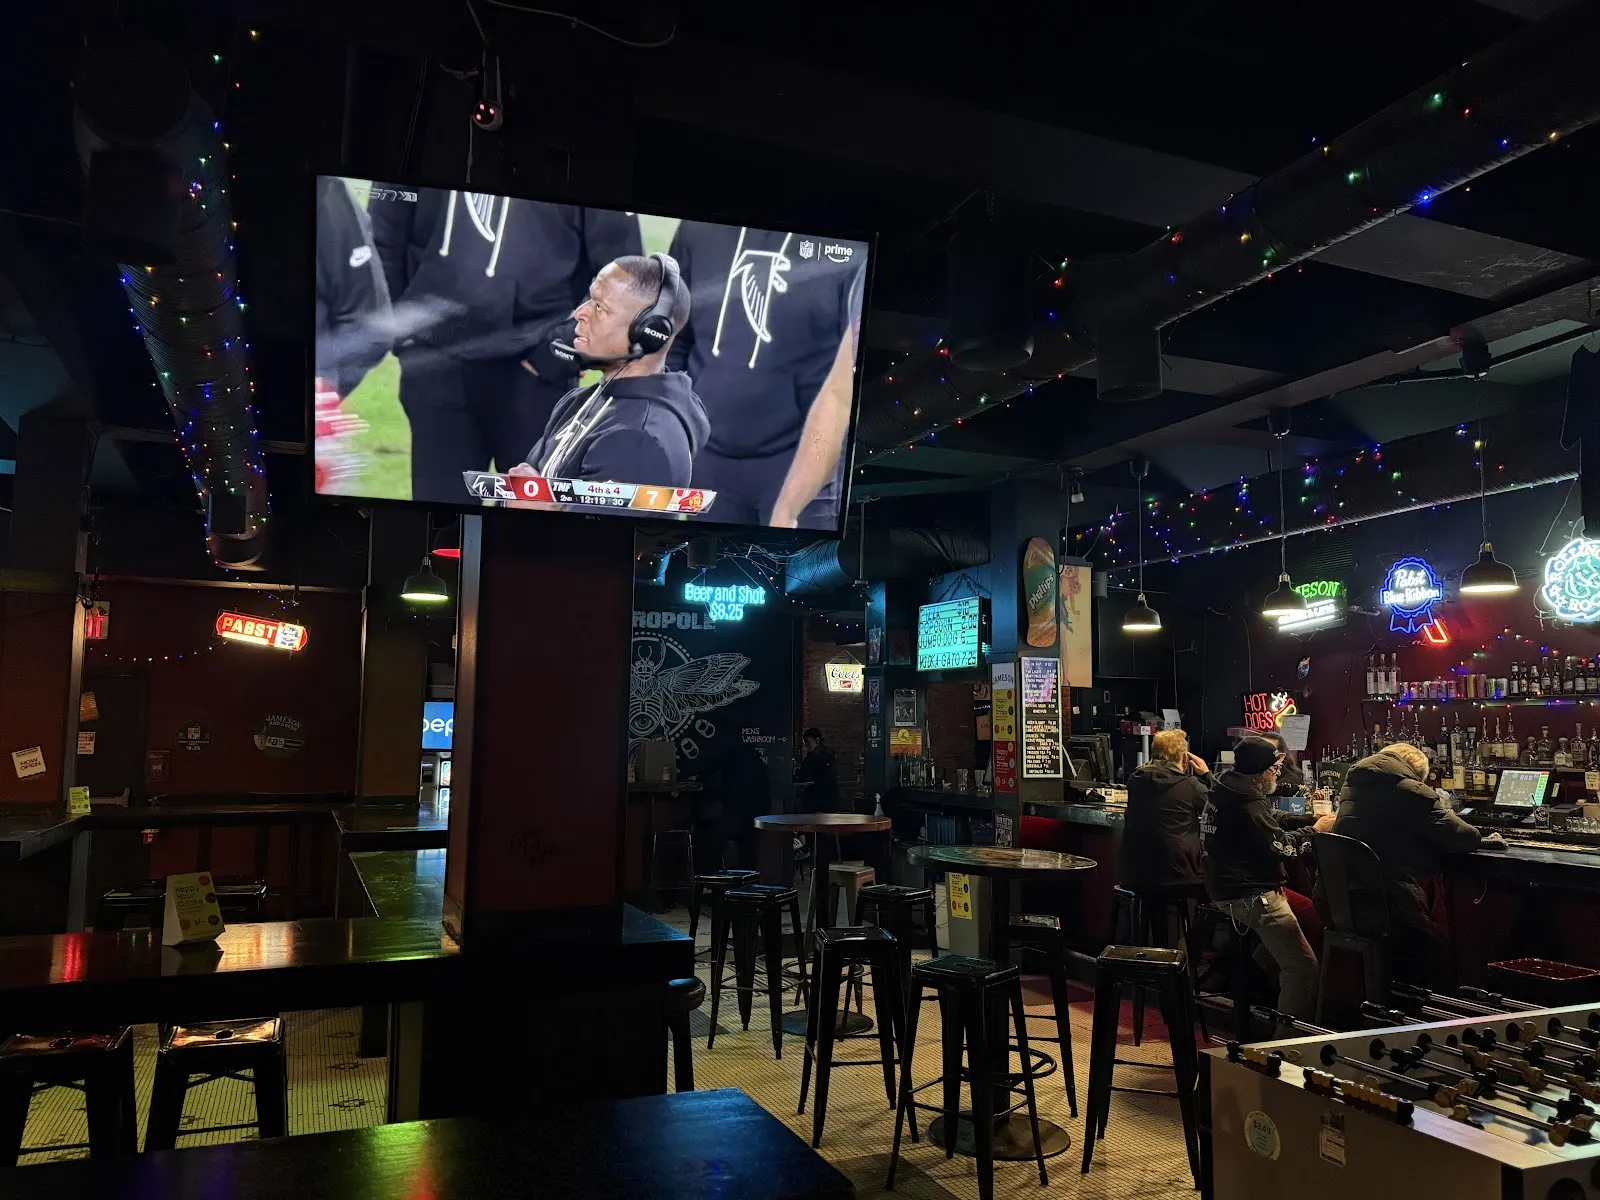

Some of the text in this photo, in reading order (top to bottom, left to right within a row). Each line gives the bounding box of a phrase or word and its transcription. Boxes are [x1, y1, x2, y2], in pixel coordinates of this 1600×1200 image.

[825, 244, 852, 256] prime
[644, 327, 668, 341] SONY
[555, 349, 574, 360] SONY
[523, 480, 539, 498] 0
[552, 482, 572, 492] TNF
[588, 485, 604, 494] 4th
[613, 487, 620, 495] 4
[580, 496, 606, 504] 12:19
[647, 490, 659, 506] 7
[1395, 569, 1426, 587] Pabst
[685, 583, 766, 604] Beer and Shot
[1028, 573, 1055, 609] Phillips
[1296, 581, 1340, 598] ESON
[1383, 587, 1440, 604] Blue Ribbon
[710, 601, 743, 621] $8.25
[222, 616, 277, 638] PABST
[920, 615, 977, 634] POPCORN 2.00
[918, 634, 941, 648] JUMBO
[943, 632, 958, 646] DOG
[961, 651, 976, 666] 7.25
[1244, 693, 1267, 711] HOT
[266, 714, 301, 730] JAMESON
[1245, 711, 1273, 729] DOGS
[741, 727, 760, 735] MENS
[741, 735, 776, 744] WASHROOM
[20, 758, 38, 766] NOW
[20, 761, 41, 770] OPEN
